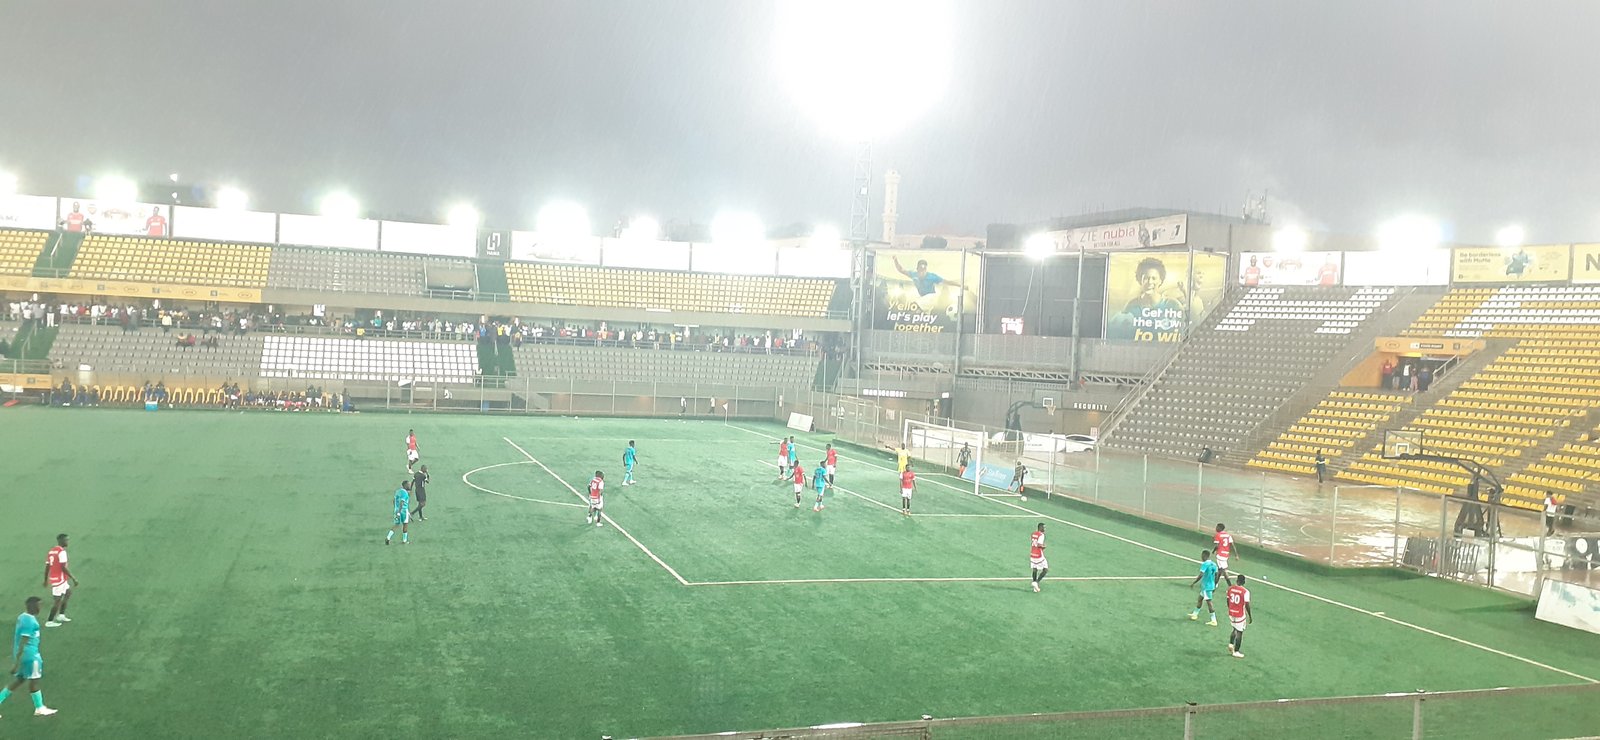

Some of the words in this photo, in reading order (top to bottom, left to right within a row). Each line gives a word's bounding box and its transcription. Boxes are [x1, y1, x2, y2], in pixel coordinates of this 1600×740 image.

[1103, 226, 1136, 240] nubia
[886, 311, 911, 322] let's
[912, 312, 938, 324] play
[1142, 307, 1162, 318] Get
[1164, 308, 1182, 319] the
[893, 321, 944, 333] together
[1133, 317, 1153, 327] the
[1134, 328, 1153, 343] to
[1073, 402, 1108, 411] SECURITY
[1223, 538, 1229, 547] 3
[1230, 593, 1241, 604] 30
